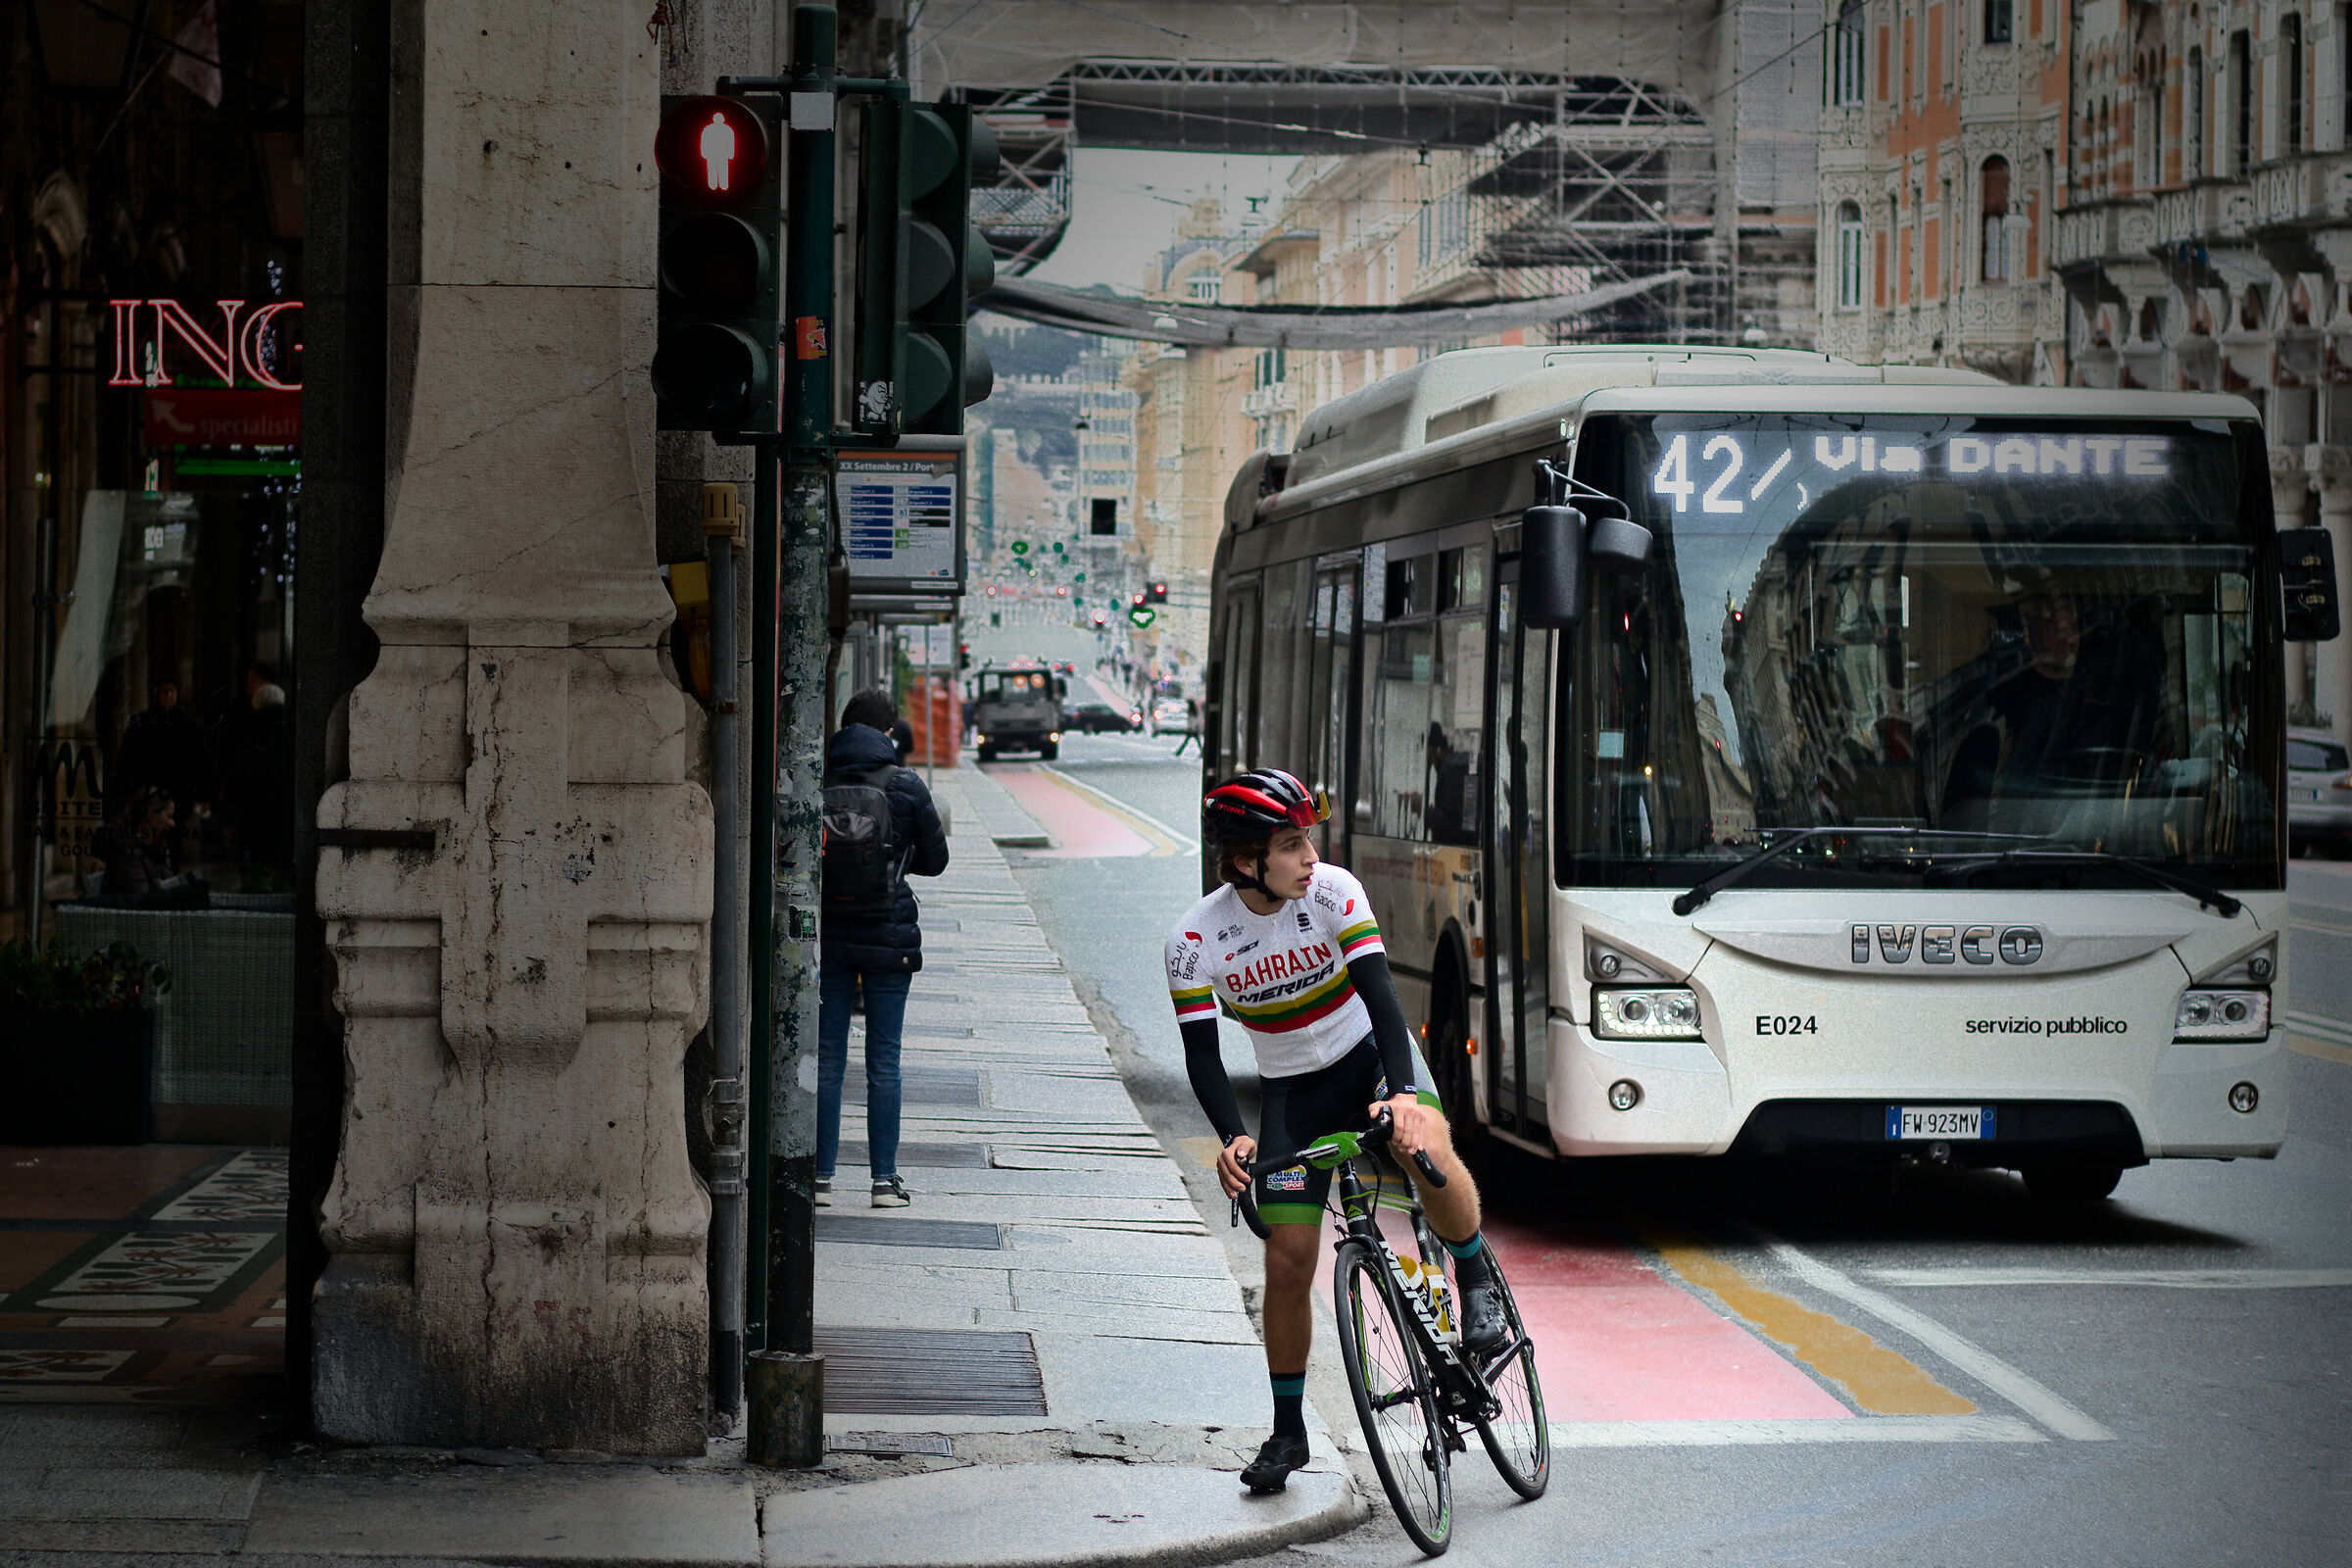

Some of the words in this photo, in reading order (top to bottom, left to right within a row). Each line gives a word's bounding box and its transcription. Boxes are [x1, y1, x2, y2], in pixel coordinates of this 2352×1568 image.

[840, 462, 853, 470] XX
[854, 462, 901, 471] Settembre
[1949, 437, 2167, 475] DANTE
[1851, 924, 2044, 966] IVECO
[1182, 952, 1200, 981] Bapco
[1225, 942, 1333, 993] BAHRAIN
[1237, 960, 1335, 1004] MERIDA
[1755, 1015, 1819, 1036] E024
[1965, 1016, 2042, 1034] servizio
[2045, 1016, 2128, 1038] pubblico
